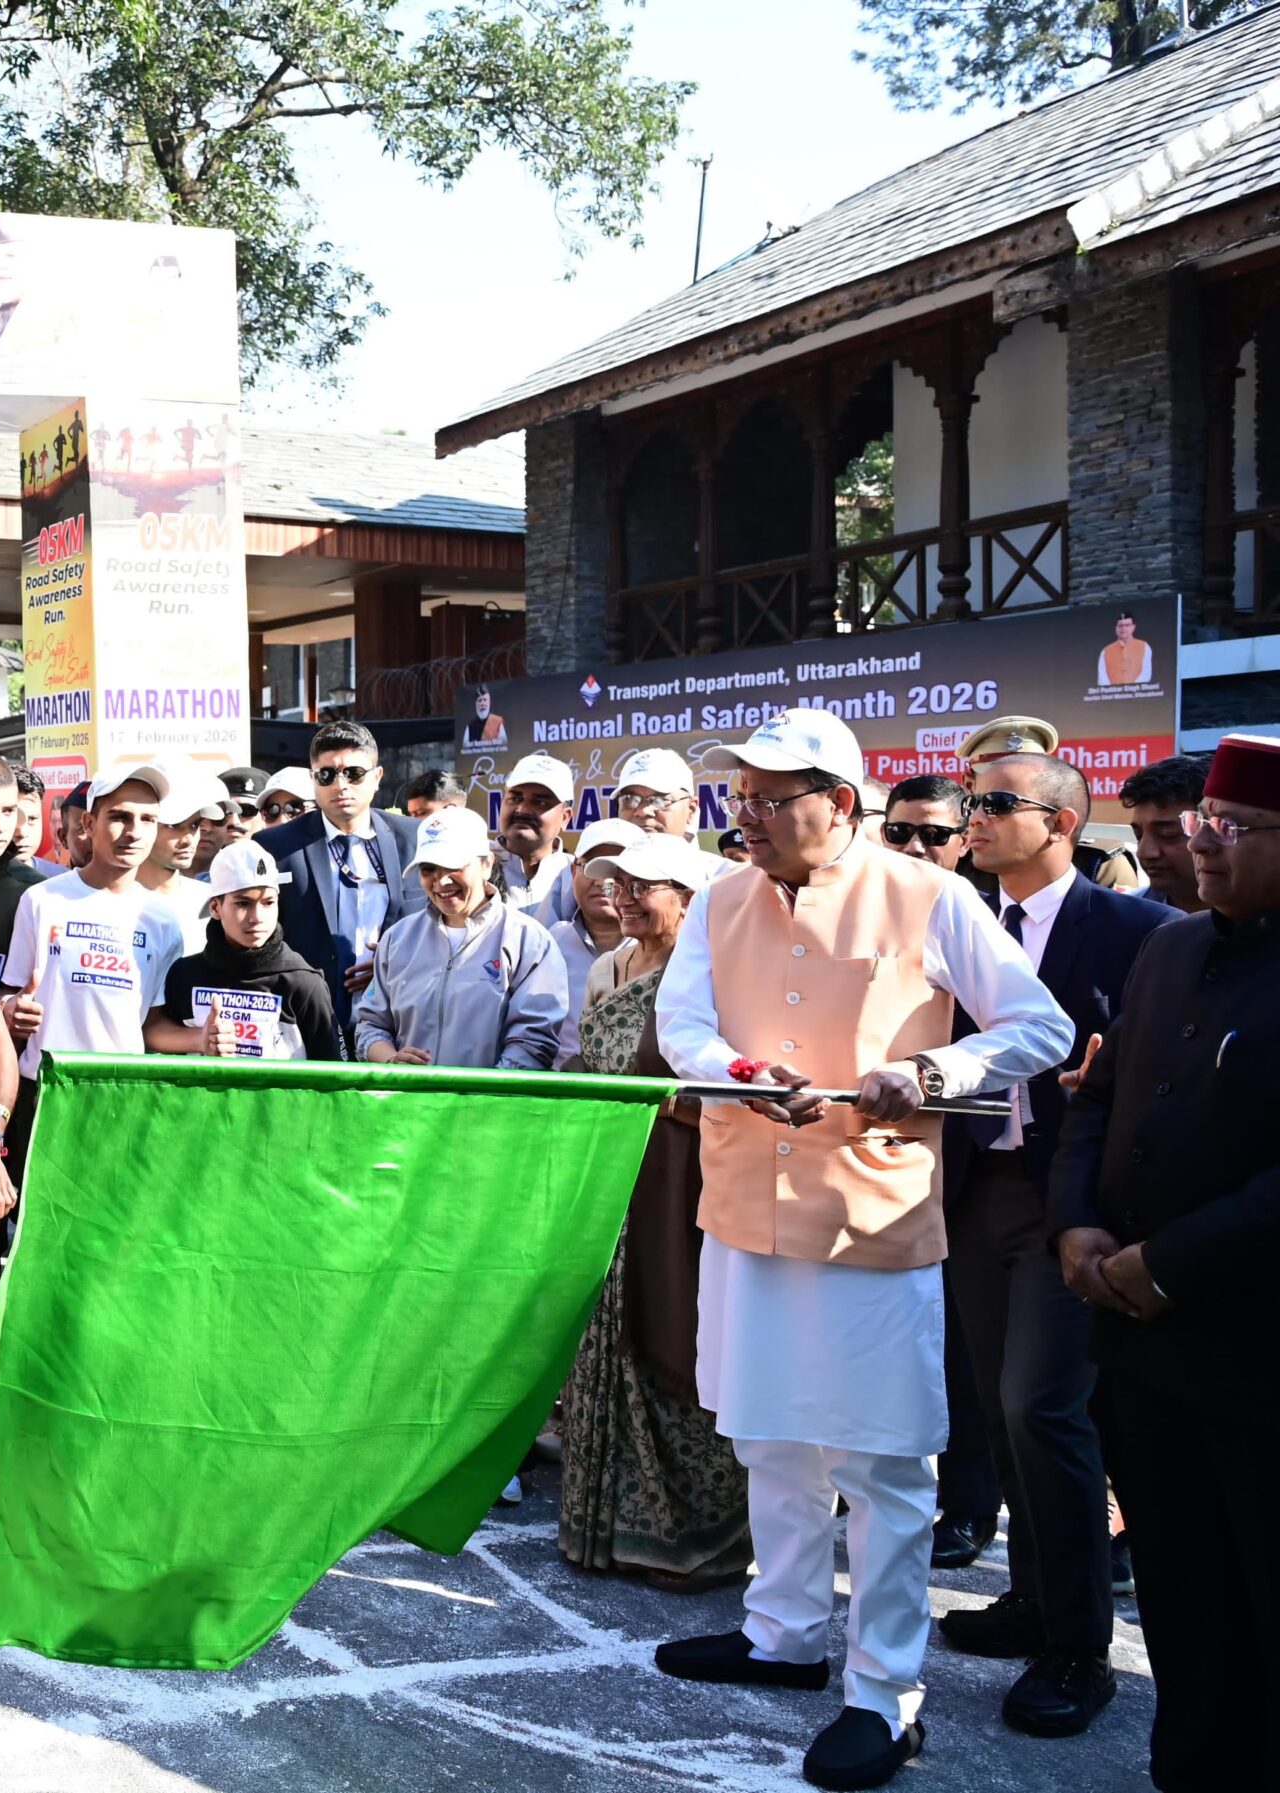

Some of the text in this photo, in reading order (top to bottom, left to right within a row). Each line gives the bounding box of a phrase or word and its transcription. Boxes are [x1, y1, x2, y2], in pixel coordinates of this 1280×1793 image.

[38, 512, 85, 567] 05KM
[138, 514, 232, 552] 05KM
[25, 562, 85, 591] Road Safety
[106, 557, 162, 574] Road
[27, 584, 83, 609] Awareness
[112, 579, 230, 595] Awareness
[43, 609, 66, 625] Run.
[607, 651, 921, 701] Transport Department, Uttarakhand
[26, 690, 91, 728] MARATHON
[104, 688, 241, 720] MARATHON
[532, 713, 624, 744] National
[631, 707, 692, 736] Road
[907, 679, 998, 717] 2026
[40, 735, 70, 751] February
[72, 732, 89, 747] 2026
[137, 730, 200, 745] February
[204, 729, 238, 743] 2026
[922, 731, 957, 748] Chief
[39, 770, 55, 785] hief
[80, 952, 131, 974] 0224
